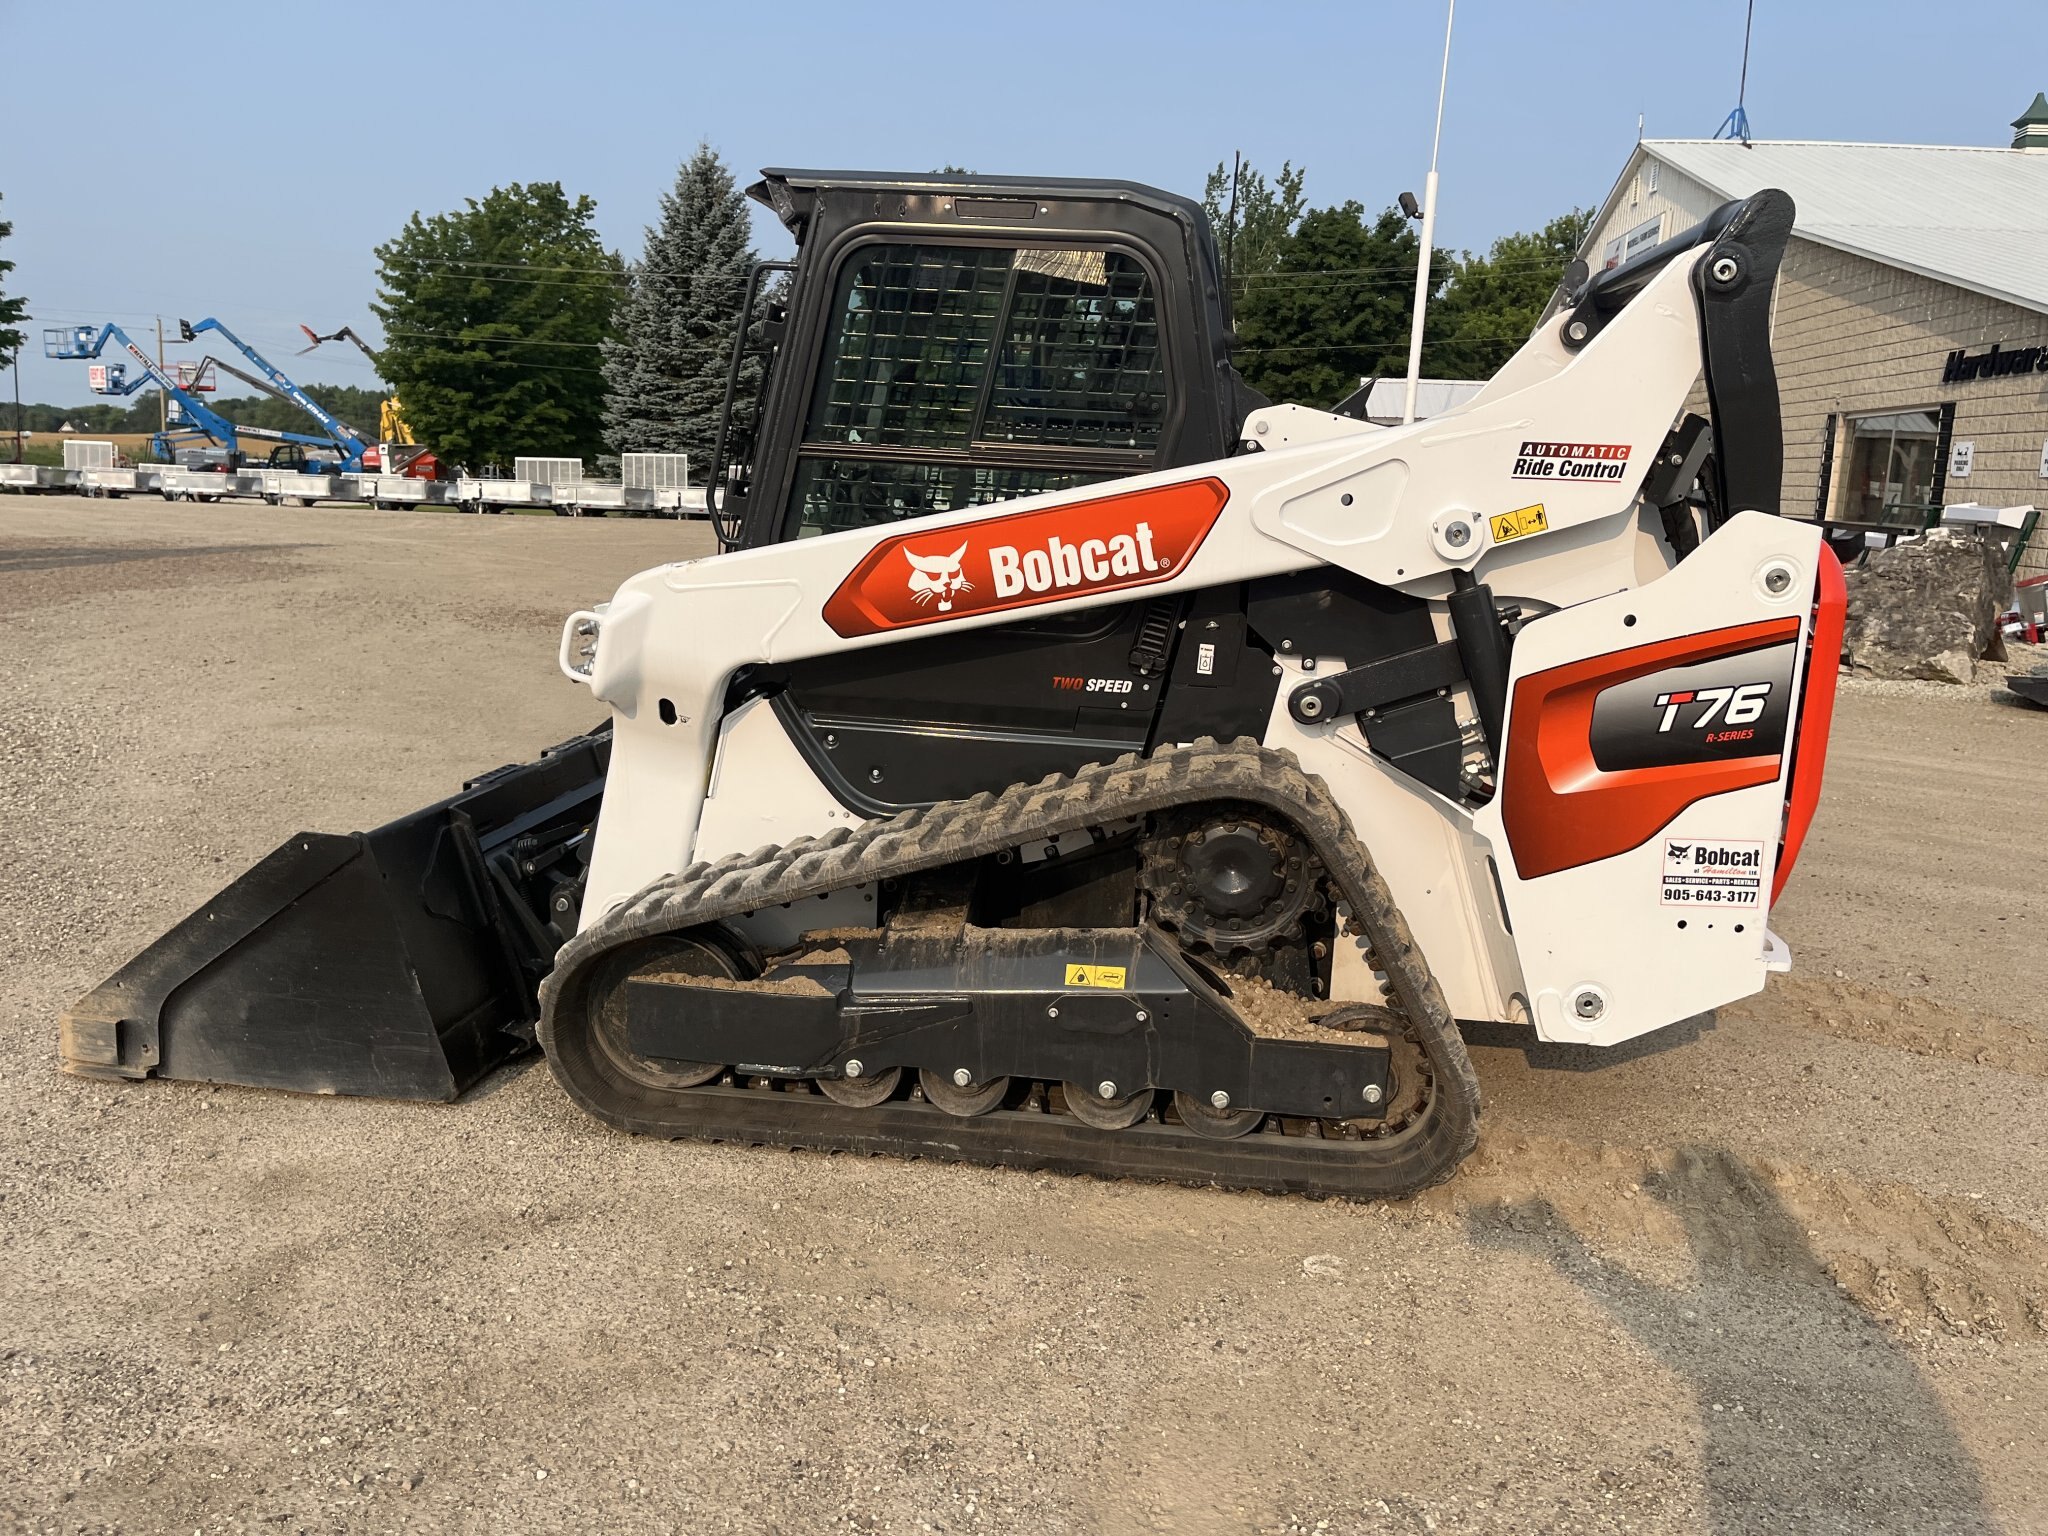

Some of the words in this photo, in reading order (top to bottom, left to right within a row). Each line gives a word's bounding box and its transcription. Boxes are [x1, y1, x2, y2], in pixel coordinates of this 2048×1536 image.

[1523, 444, 1627, 459] AUTOMATIC
[1512, 458, 1555, 476] Ride
[1558, 459, 1627, 479] Control
[988, 521, 1159, 599] Bobcat
[1052, 676, 1084, 691] TWO
[1085, 678, 1133, 694] SPEED
[1655, 683, 1771, 733] T76
[1705, 728, 1755, 743] R-SERIES
[1694, 846, 1760, 867] Bobcat
[1701, 865, 1747, 875] Hamilton
[1663, 888, 1757, 903] 905-643-3177
